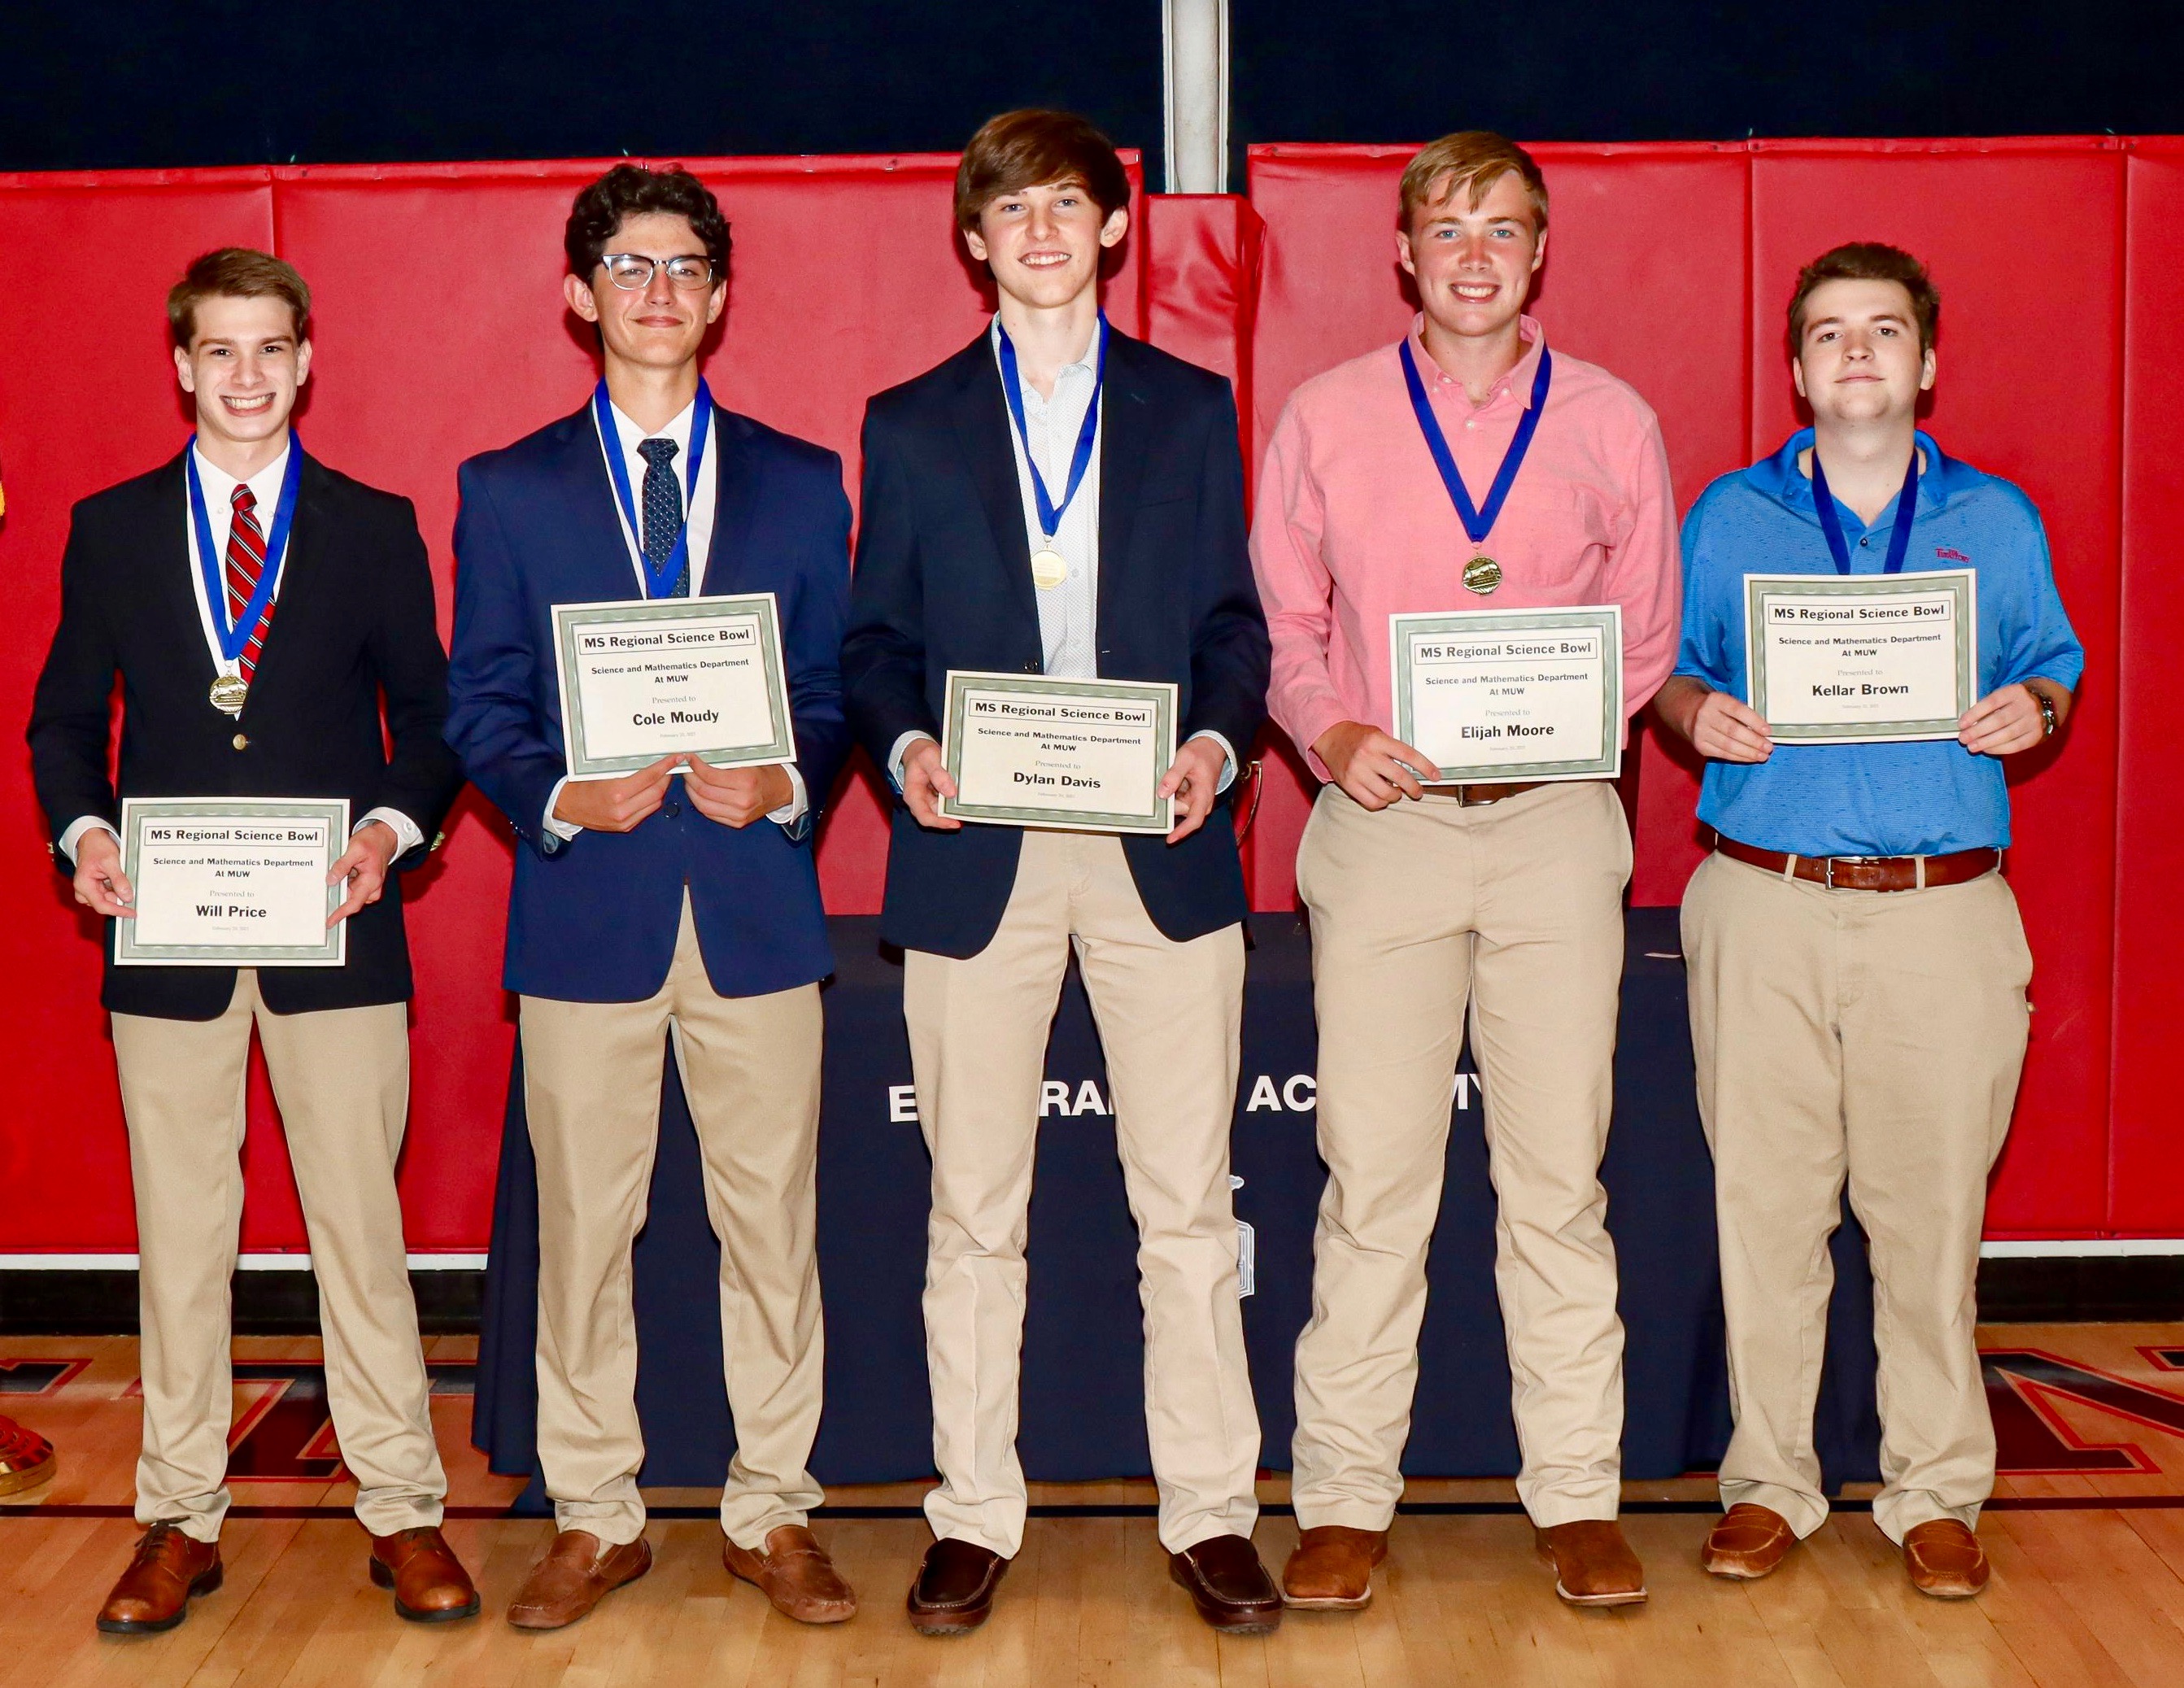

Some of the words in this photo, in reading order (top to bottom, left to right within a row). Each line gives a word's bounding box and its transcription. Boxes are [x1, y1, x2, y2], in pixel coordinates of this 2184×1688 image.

[1775, 608, 1794, 618] MS
[1800, 609, 1854, 621] Regional
[1859, 608, 1908, 618] Science
[1914, 605, 1944, 616] Bowl
[584, 638, 605, 648] MS
[610, 635, 663, 648] Regional
[668, 633, 714, 643] Science
[720, 630, 749, 640] Bowl
[1833, 636, 1887, 644] Mathematics
[1890, 635, 1941, 643] Department
[1421, 648, 1441, 657] MS
[1447, 645, 1501, 658] Regional
[1506, 645, 1555, 654] Science
[1561, 643, 1590, 652] Bowl
[591, 666, 624, 674] Science
[645, 662, 697, 671] Mathematics
[700, 659, 748, 670] Department
[1538, 673, 1588, 682] Department
[1812, 685, 1855, 696] Kellar
[1862, 684, 1908, 695] Brown
[652, 696, 687, 704] Presented
[633, 713, 665, 726] Cole
[671, 710, 719, 724] Moudy
[975, 703, 996, 712] MS
[1002, 704, 1055, 717] Regional
[1061, 709, 1109, 719] Science
[1115, 712, 1145, 722] Bowl
[978, 728, 1011, 736] Science
[1033, 732, 1087, 741] Mathematics
[1091, 736, 1140, 745] Department
[1462, 726, 1501, 740] Elijah
[1507, 725, 1554, 736] Moore
[1035, 761, 1071, 769] Presented
[1014, 772, 1055, 785] Dylan
[1061, 776, 1101, 788] Davis
[151, 831, 171, 840] MS
[177, 831, 229, 841] Regional
[234, 831, 282, 840] Science
[288, 831, 317, 841] Bowl
[264, 859, 313, 868] Department
[196, 905, 222, 917] Will
[229, 906, 266, 918] Price
